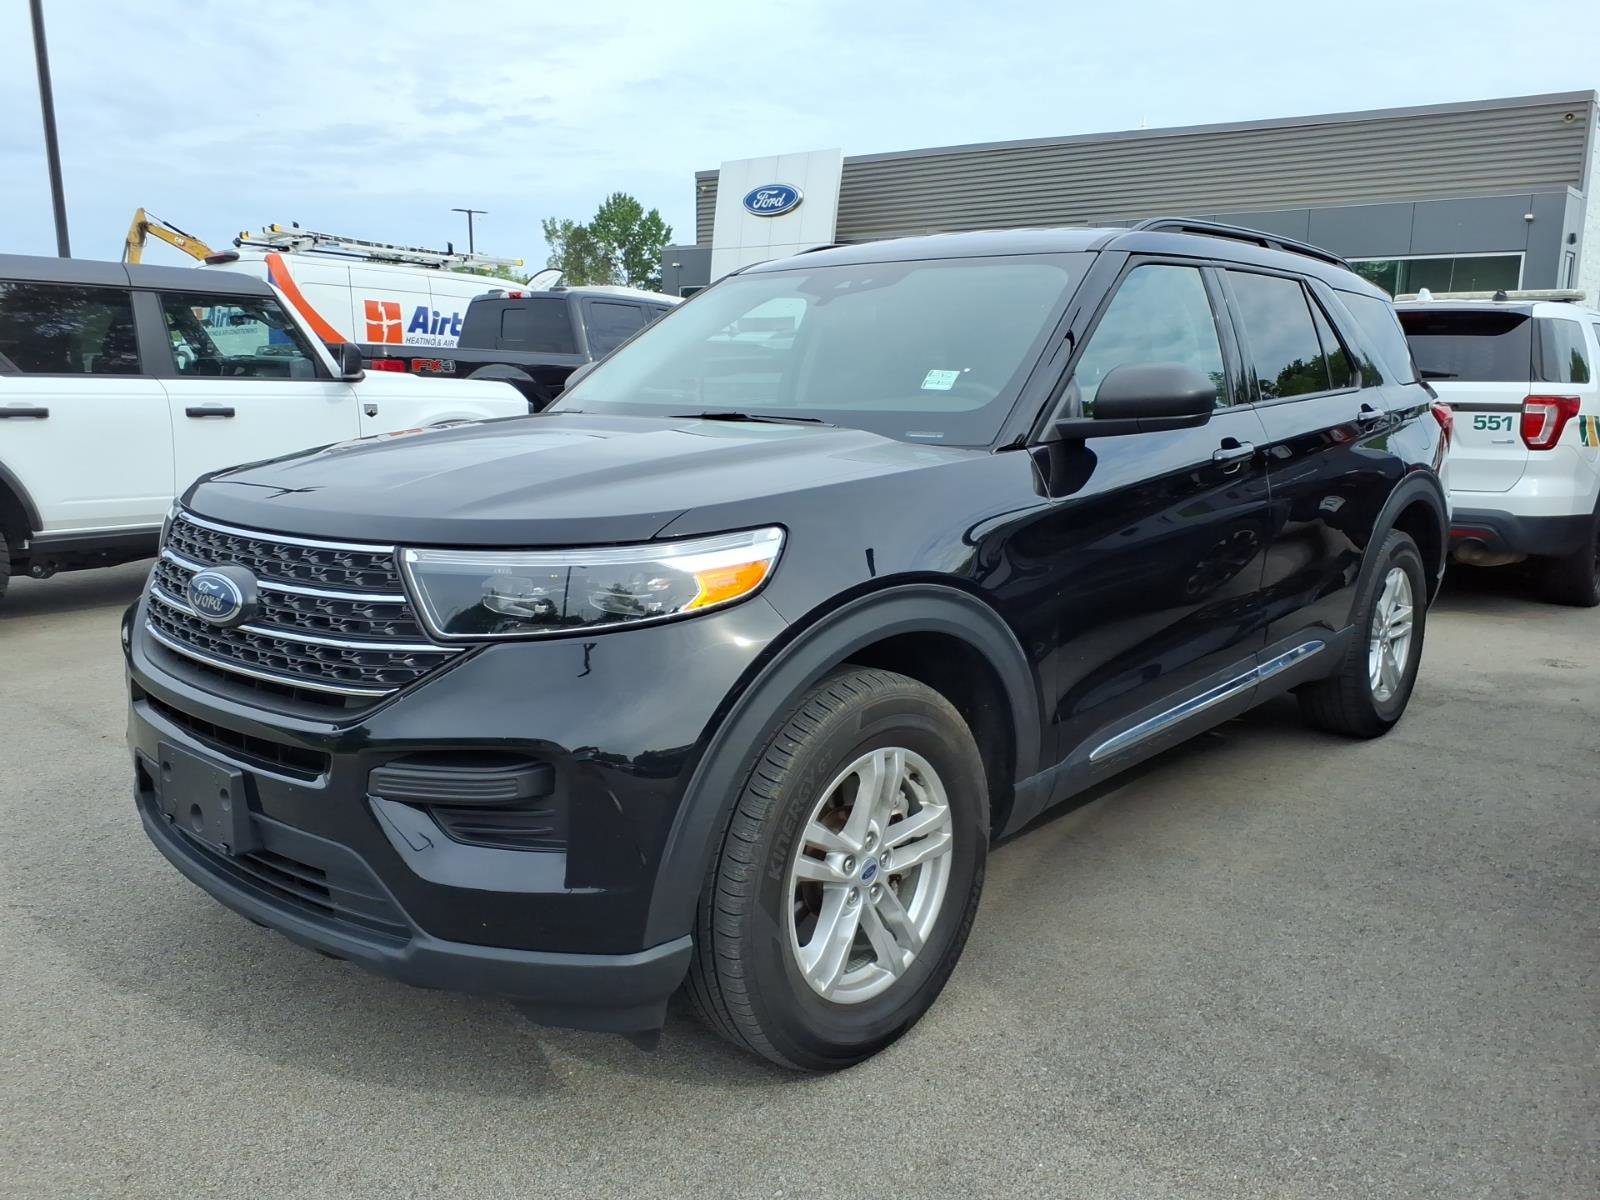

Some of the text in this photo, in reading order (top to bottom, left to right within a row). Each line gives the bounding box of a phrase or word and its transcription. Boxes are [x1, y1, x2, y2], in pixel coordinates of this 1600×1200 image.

[753, 190, 786, 208] Ford
[407, 306, 462, 337] Airt
[406, 337, 435, 345] HEATING
[412, 358, 456, 373] FX4
[1473, 415, 1513, 431] 551
[194, 581, 224, 611] Ford
